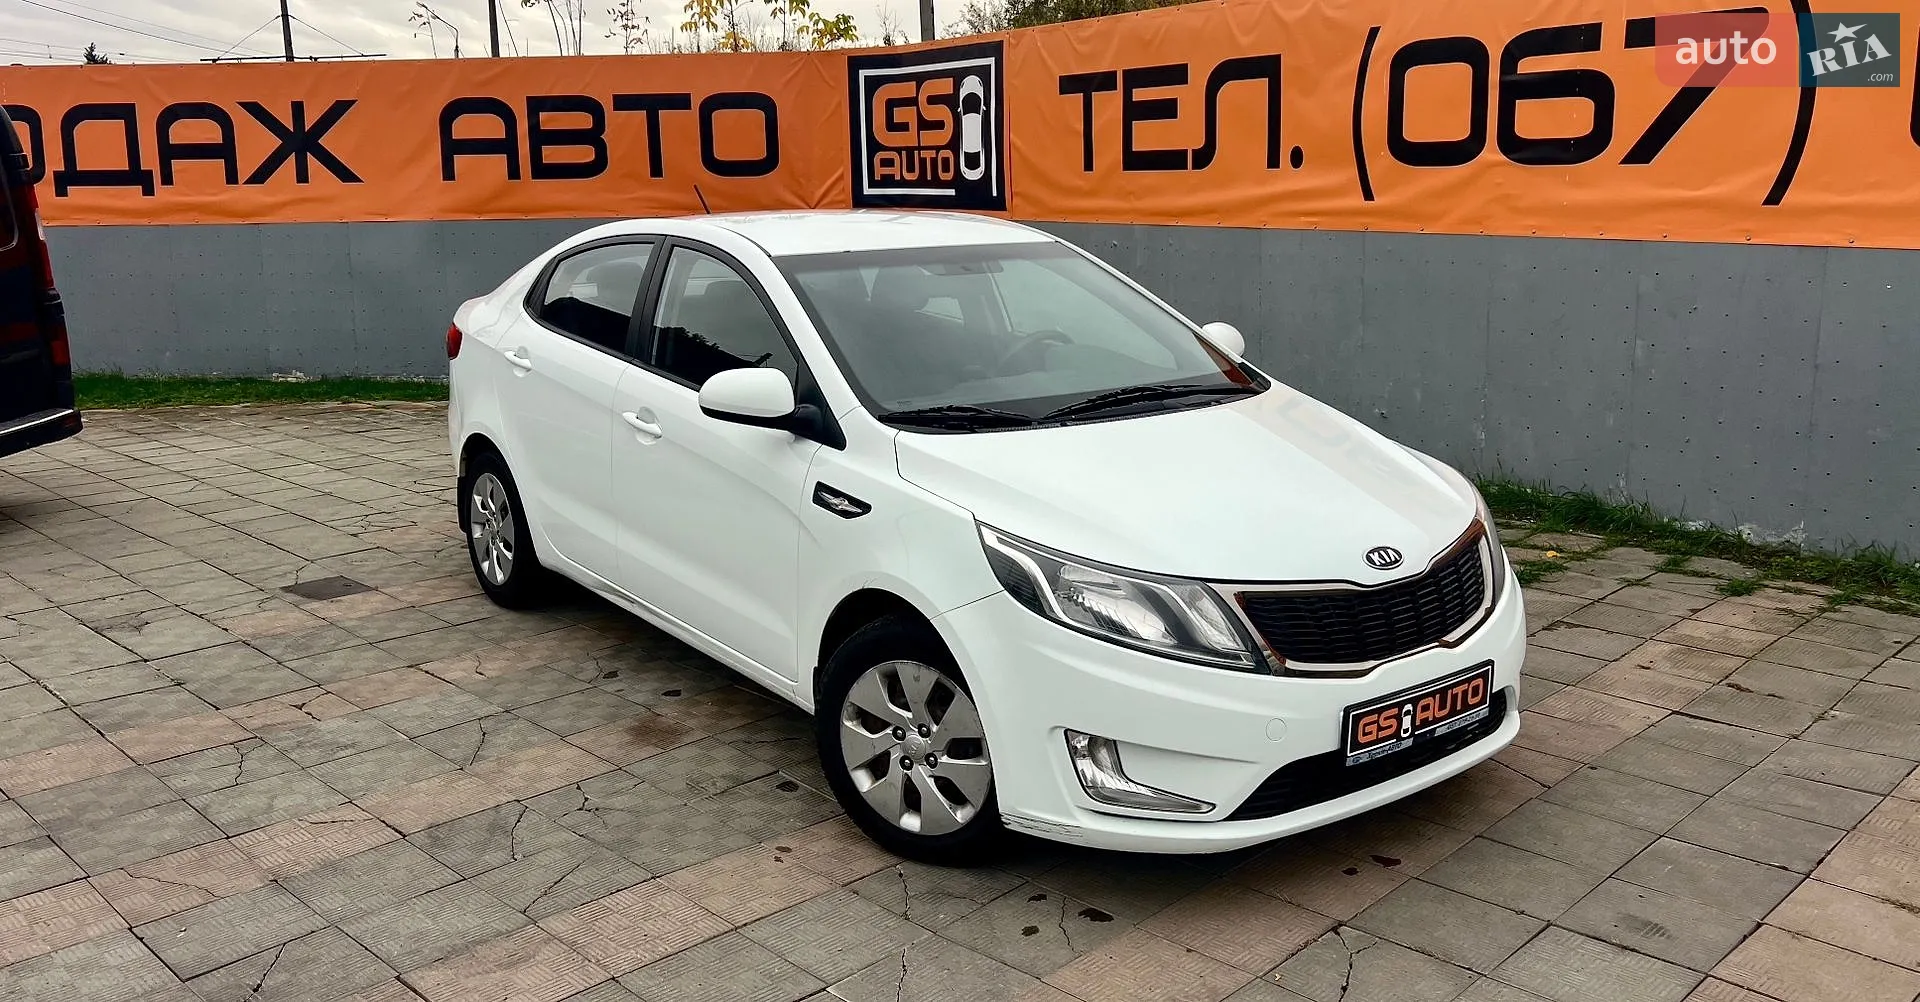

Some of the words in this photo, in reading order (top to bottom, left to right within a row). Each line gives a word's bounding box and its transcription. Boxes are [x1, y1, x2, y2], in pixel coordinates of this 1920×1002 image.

[439, 91, 781, 182] АВТО
[872, 77, 954, 147] GS
[1058, 53, 1304, 172] ТЕЛ.
[873, 149, 954, 181] AUTO
[1367, 548, 1401, 566] KIA
[1357, 707, 1399, 744] GS
[1415, 677, 1484, 726] AUTO
